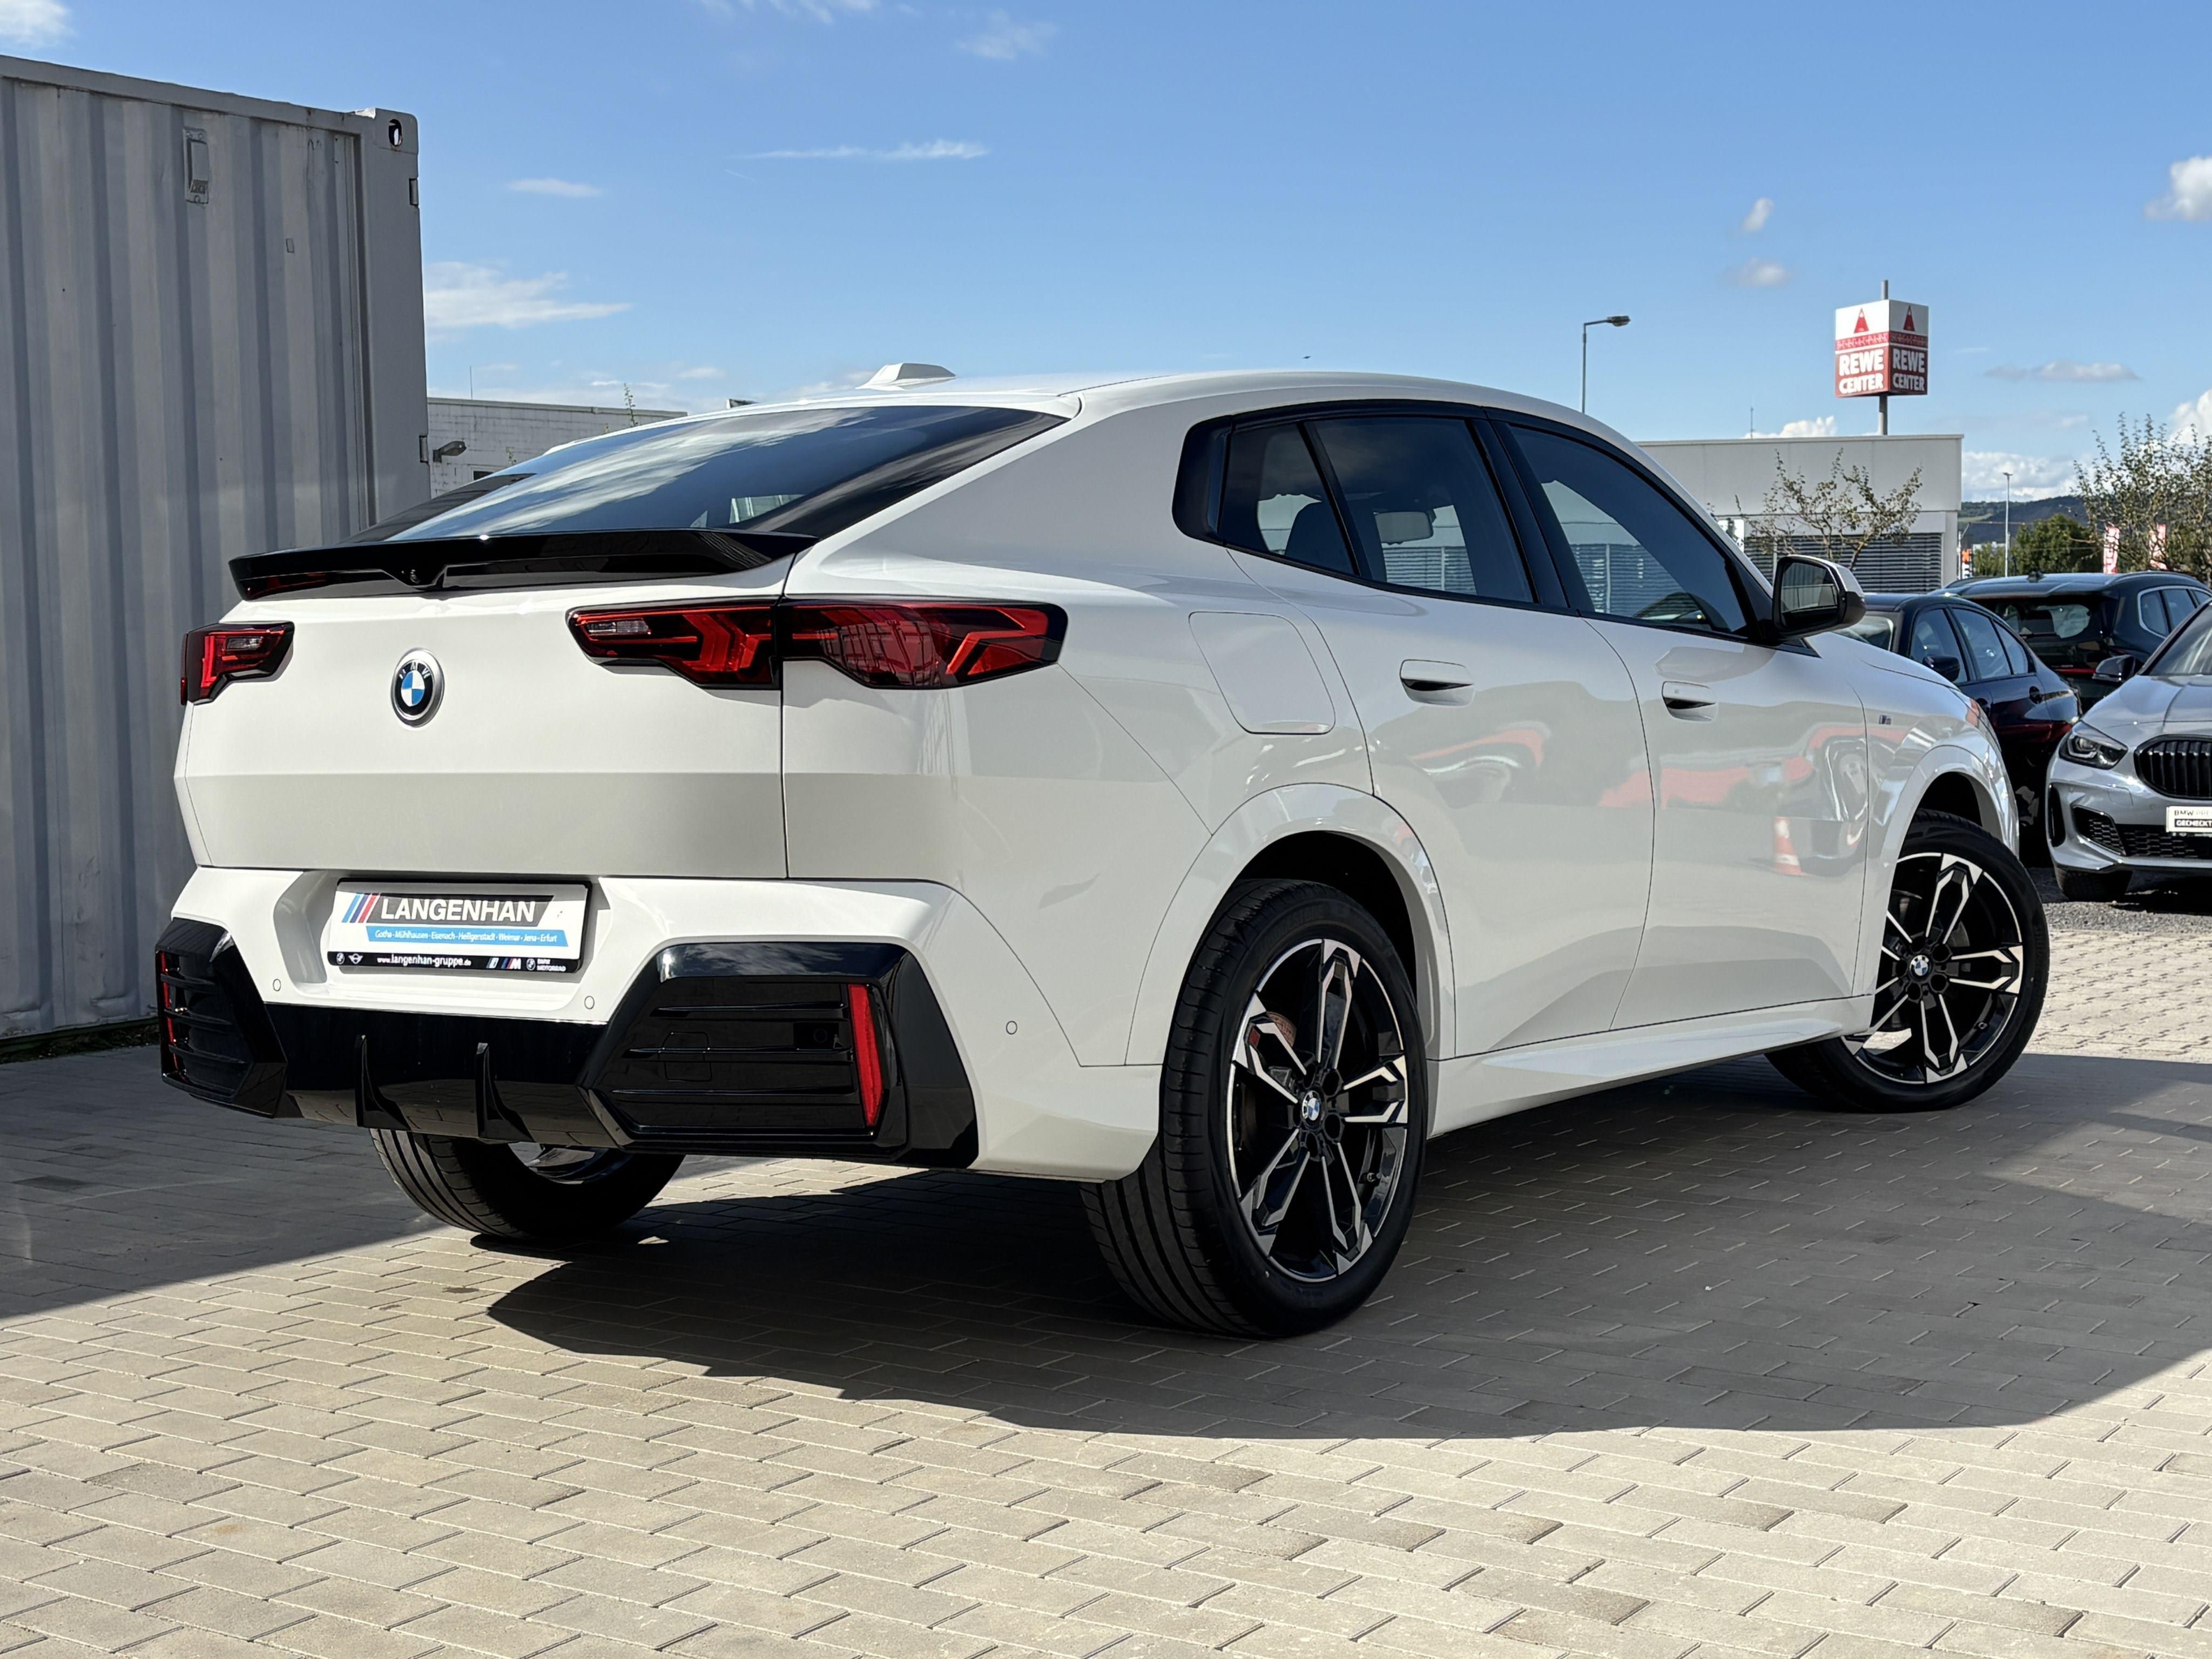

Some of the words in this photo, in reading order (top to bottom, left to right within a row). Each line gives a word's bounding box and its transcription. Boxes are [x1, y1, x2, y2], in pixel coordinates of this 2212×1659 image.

[1839, 349, 1884, 376] REWE
[1893, 348, 1925, 373] REWE
[1839, 373, 1884, 394] CENTER
[1893, 373, 1925, 391] CENTER
[381, 898, 536, 922] LANGENHAN
[375, 929, 393, 938] Gotha
[394, 930, 428, 939] Mühlhausen
[498, 933, 521, 942] Weimar
[523, 934, 537, 942] Jena
[540, 934, 557, 942] Erfurt
[377, 953, 471, 968] www.langenhan-gruppe.de
